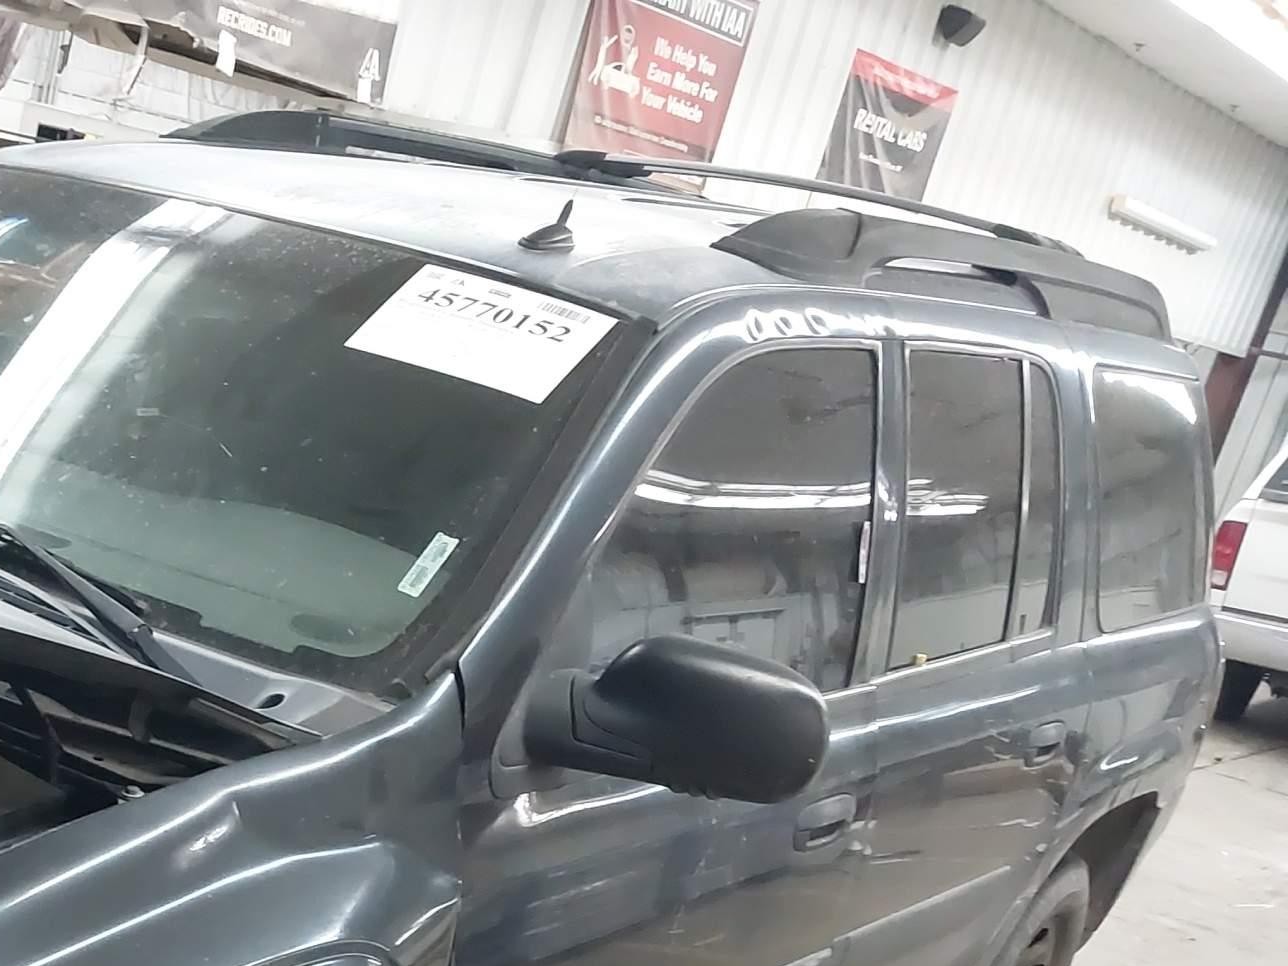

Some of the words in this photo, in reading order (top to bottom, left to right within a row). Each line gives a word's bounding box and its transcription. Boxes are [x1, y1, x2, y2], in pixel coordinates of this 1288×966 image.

[688, 0, 723, 28] WITH
[721, 7, 746, 38] IAA
[654, 36, 672, 59] We
[672, 44, 697, 72] Help
[698, 53, 717, 77] You
[646, 62, 672, 86] Earn
[672, 71, 700, 97] More
[699, 81, 718, 103] For
[641, 86, 666, 110] Your
[667, 94, 703, 123] Vehicle
[853, 108, 896, 143] RENTAL
[896, 129, 928, 152] CARS
[418, 288, 571, 343] 45770152
